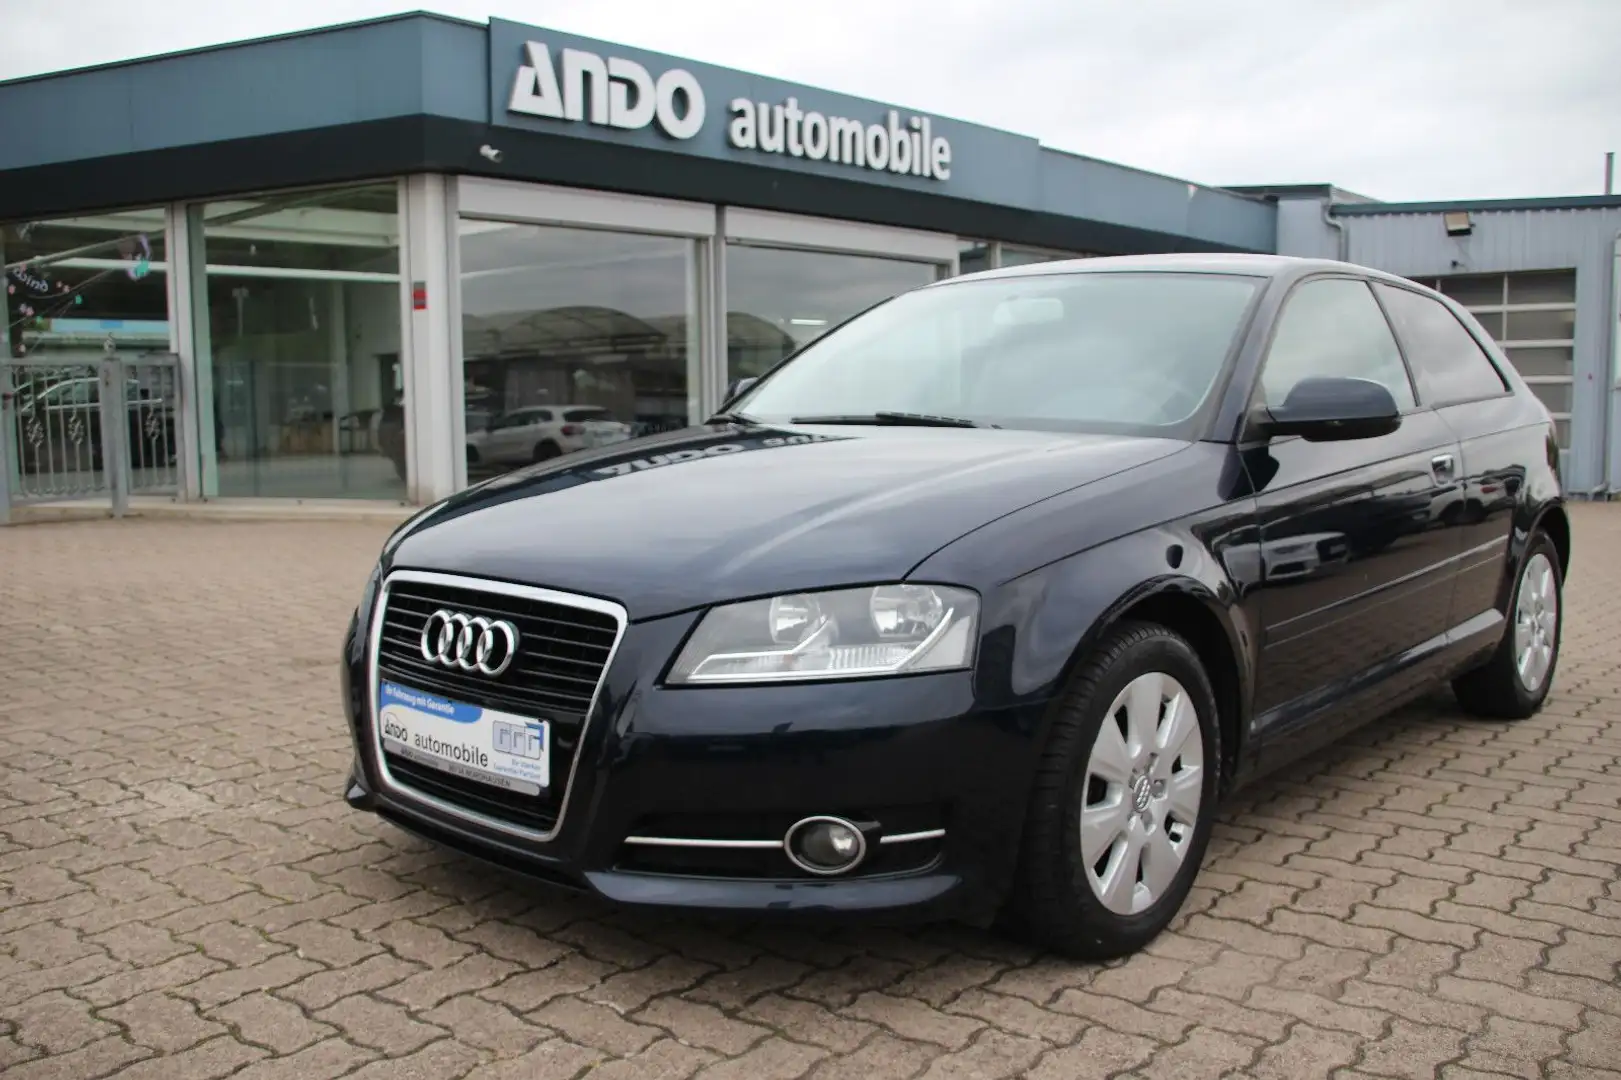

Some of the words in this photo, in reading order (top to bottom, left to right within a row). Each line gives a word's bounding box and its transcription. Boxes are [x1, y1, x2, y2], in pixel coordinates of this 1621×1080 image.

[508, 40, 705, 140] ANDO
[729, 97, 951, 181] automobile
[426, 697, 455, 715] Garantie
[414, 733, 488, 768] automobile
